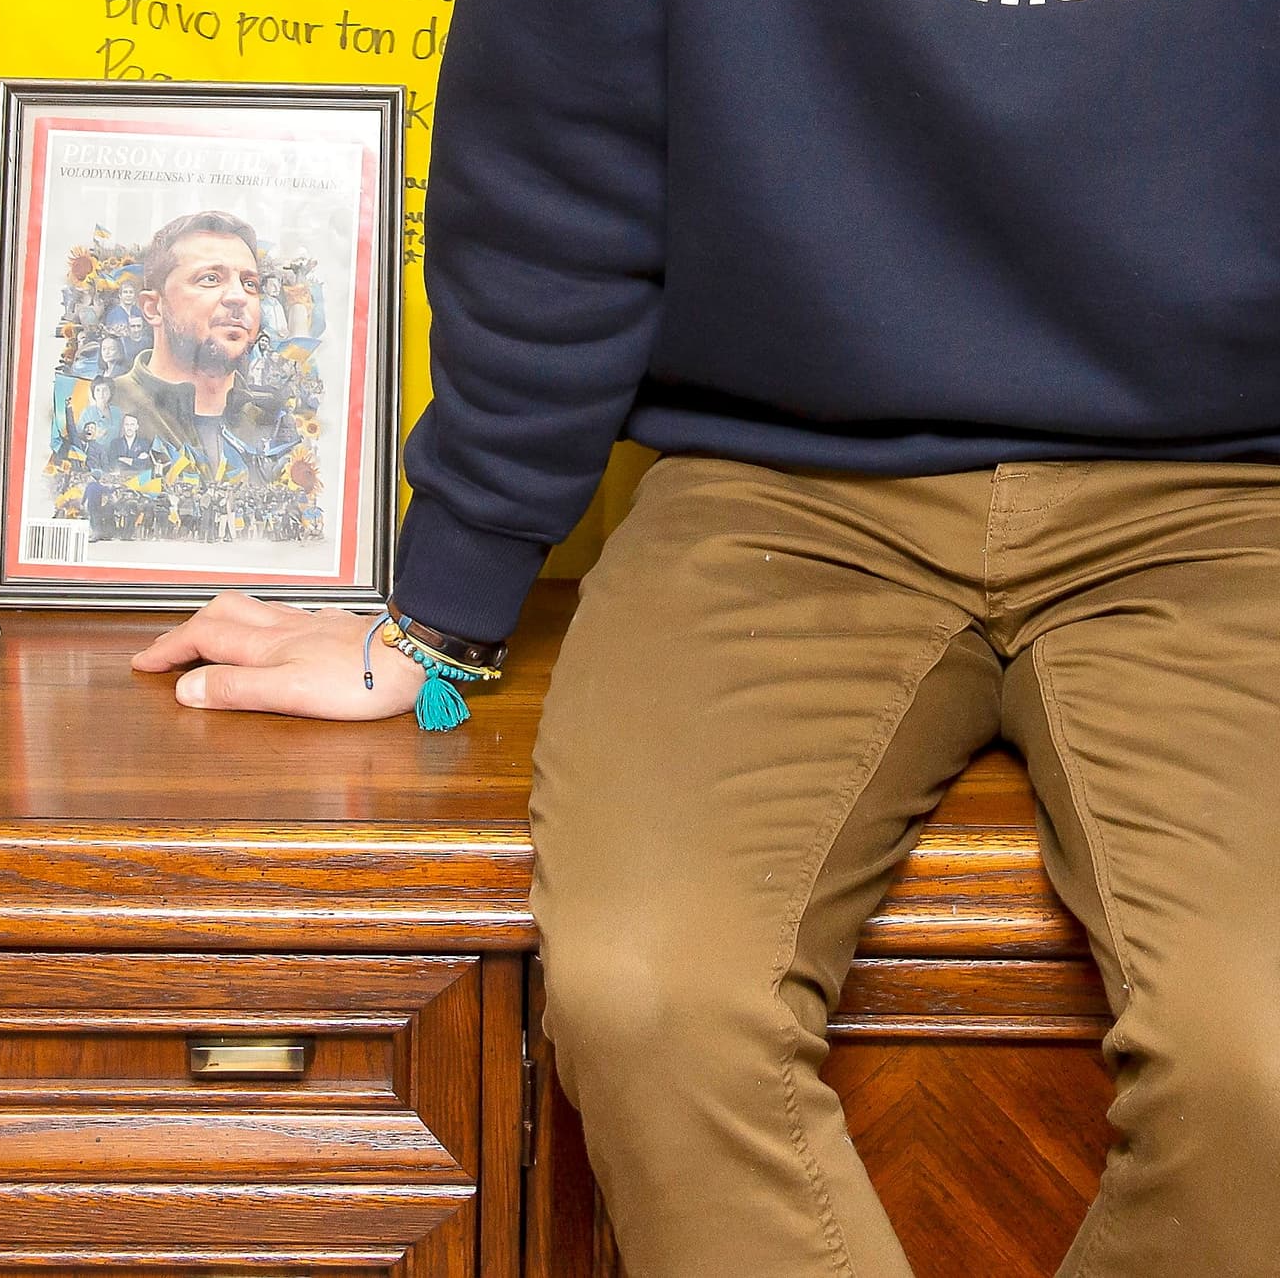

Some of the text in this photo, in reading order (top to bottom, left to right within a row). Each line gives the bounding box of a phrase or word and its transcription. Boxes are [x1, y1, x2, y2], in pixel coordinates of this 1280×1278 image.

[236, 11, 324, 57] pour
[335, 9, 396, 55] ton
[62, 143, 169, 170] PERSON
[59, 166, 132, 181] VOLODYMYR
[132, 169, 195, 184] ZELENSKY
[208, 173, 234, 186] THE
[291, 178, 343, 192] UKRAIN
